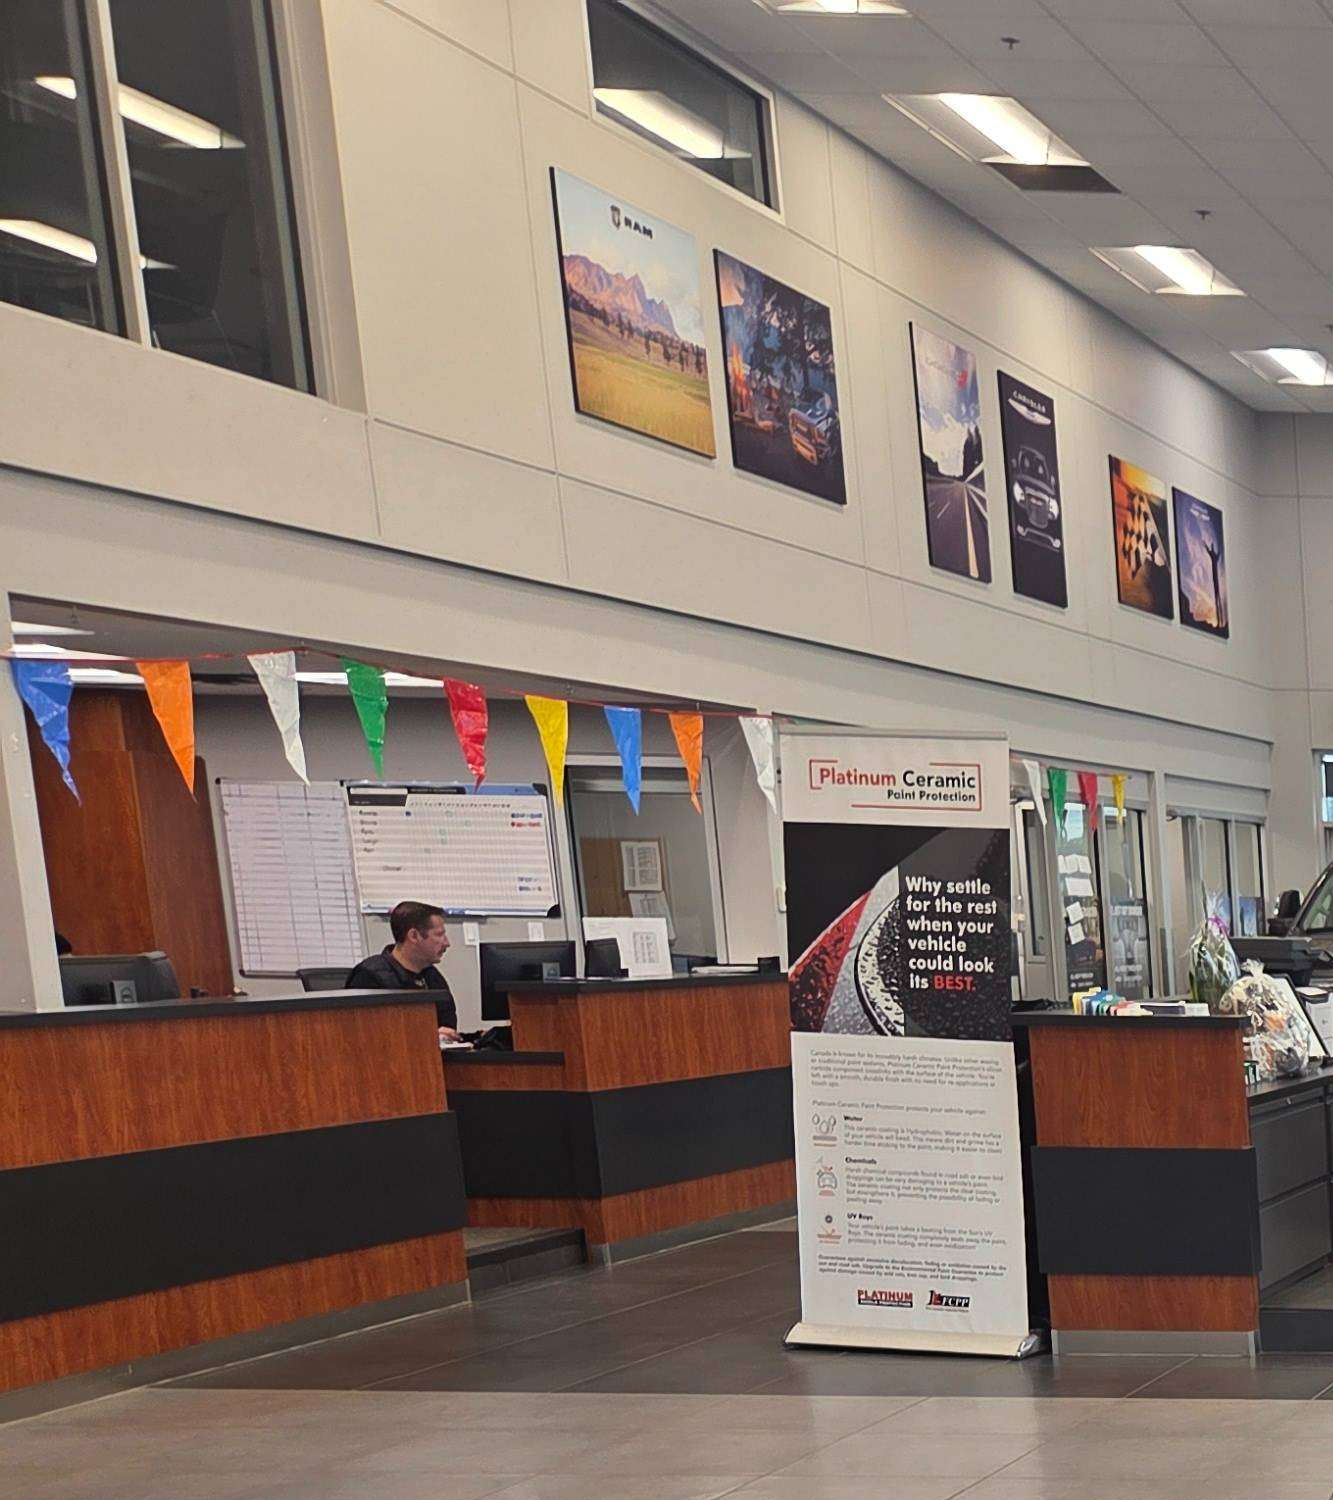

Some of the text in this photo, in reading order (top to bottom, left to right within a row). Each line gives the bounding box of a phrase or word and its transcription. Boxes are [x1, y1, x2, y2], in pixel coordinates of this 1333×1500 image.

[819, 767, 976, 789] Platinum Ceramic
[887, 789, 976, 802] Paint Protection
[906, 876, 991, 897] Why settle
[906, 896, 998, 914] for the rest
[907, 917, 994, 937] when your
[908, 935, 967, 952] vehicle
[908, 954, 995, 973] could look
[910, 973, 977, 991] its BEST.
[857, 1289, 913, 1302] PLATINUM
